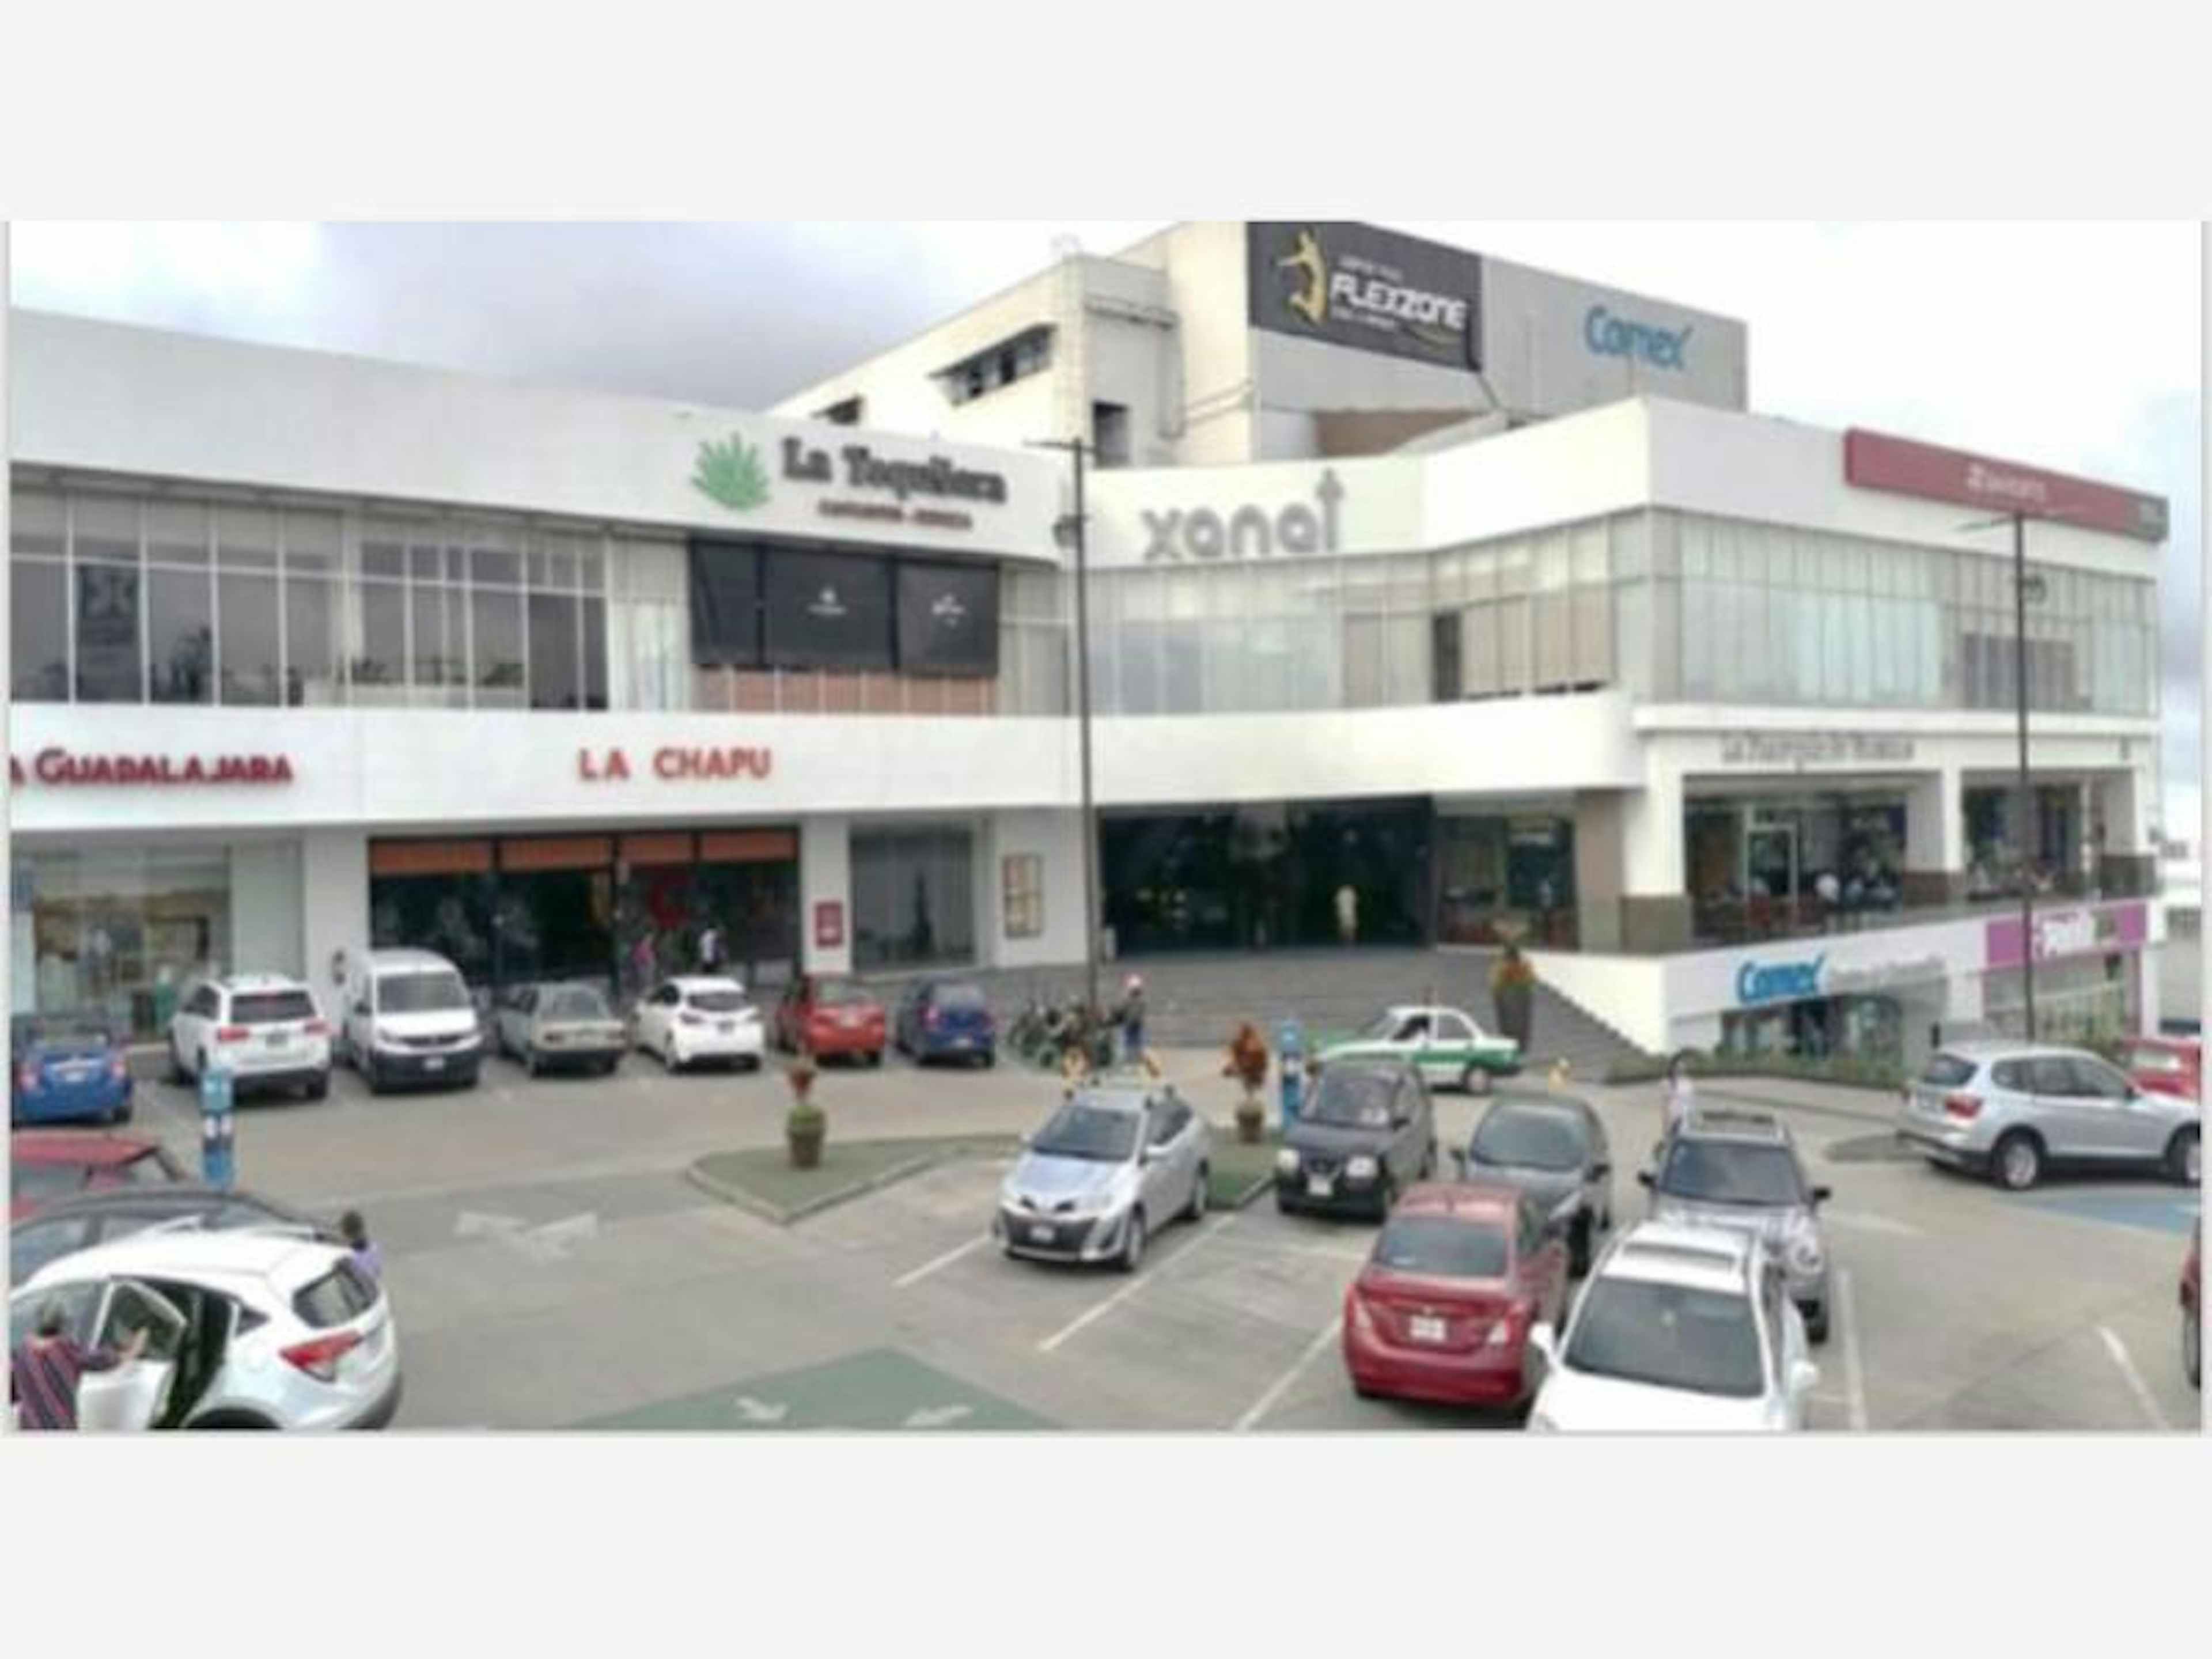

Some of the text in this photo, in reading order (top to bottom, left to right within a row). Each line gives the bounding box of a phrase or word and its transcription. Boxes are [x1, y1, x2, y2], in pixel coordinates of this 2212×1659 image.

[1584, 305, 1694, 371] Comex
[783, 436, 1007, 505] La Tequilera
[35, 747, 294, 784] GUADALAJARA
[578, 748, 772, 780] LA CHAPU
[1736, 949, 1827, 1006] Comex
